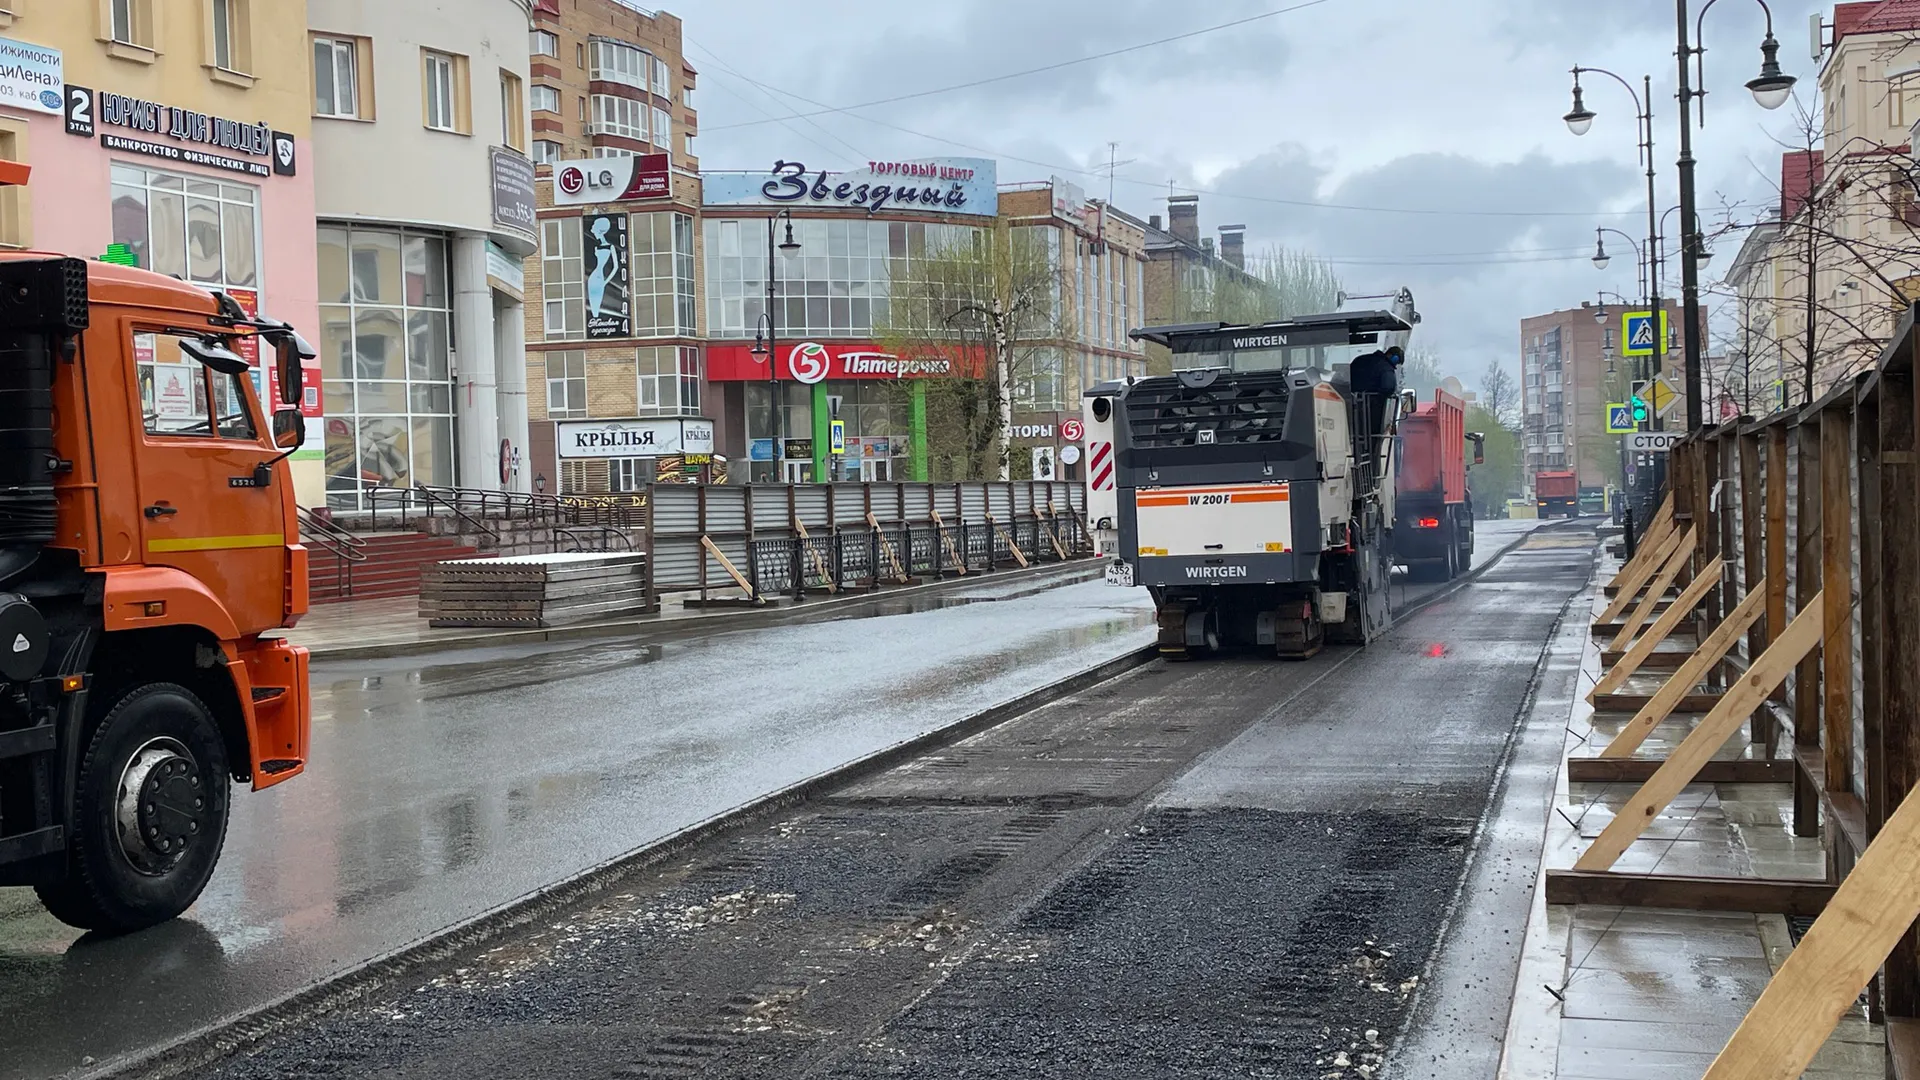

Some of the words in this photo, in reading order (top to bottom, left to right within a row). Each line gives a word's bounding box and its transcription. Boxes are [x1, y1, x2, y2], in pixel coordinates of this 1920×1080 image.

[72, 89, 91, 123] 2
[70, 121, 93, 133] ЭТАЖ
[101, 92, 164, 133] ЮРИСТ
[169, 107, 208, 142] ДЛЯ
[212, 117, 271, 156] ЛЮДЕЙ
[107, 136, 179, 158] БАНКРОТСТВО
[184, 151, 245, 171] ФИЗИЧЕСКИХ
[249, 162, 269, 176] ЛИЦ
[588, 170, 614, 188] LG
[869, 161, 937, 177] ТОРГОВЫЙ
[940, 165, 974, 181] ЦЕНТР
[761, 159, 968, 212] Звездный
[617, 217, 630, 334] ШОКОЛАД
[1233, 335, 1288, 348] WIRTGEN
[575, 430, 655, 447] КРЫЛЬЯ
[1009, 424, 1053, 437] ТОРЫ
[685, 454, 711, 464] ШАУРМА
[1190, 496, 1201, 505] W
[1108, 566, 1130, 575] 4352
[1185, 565, 1247, 578] WIRTGEN
